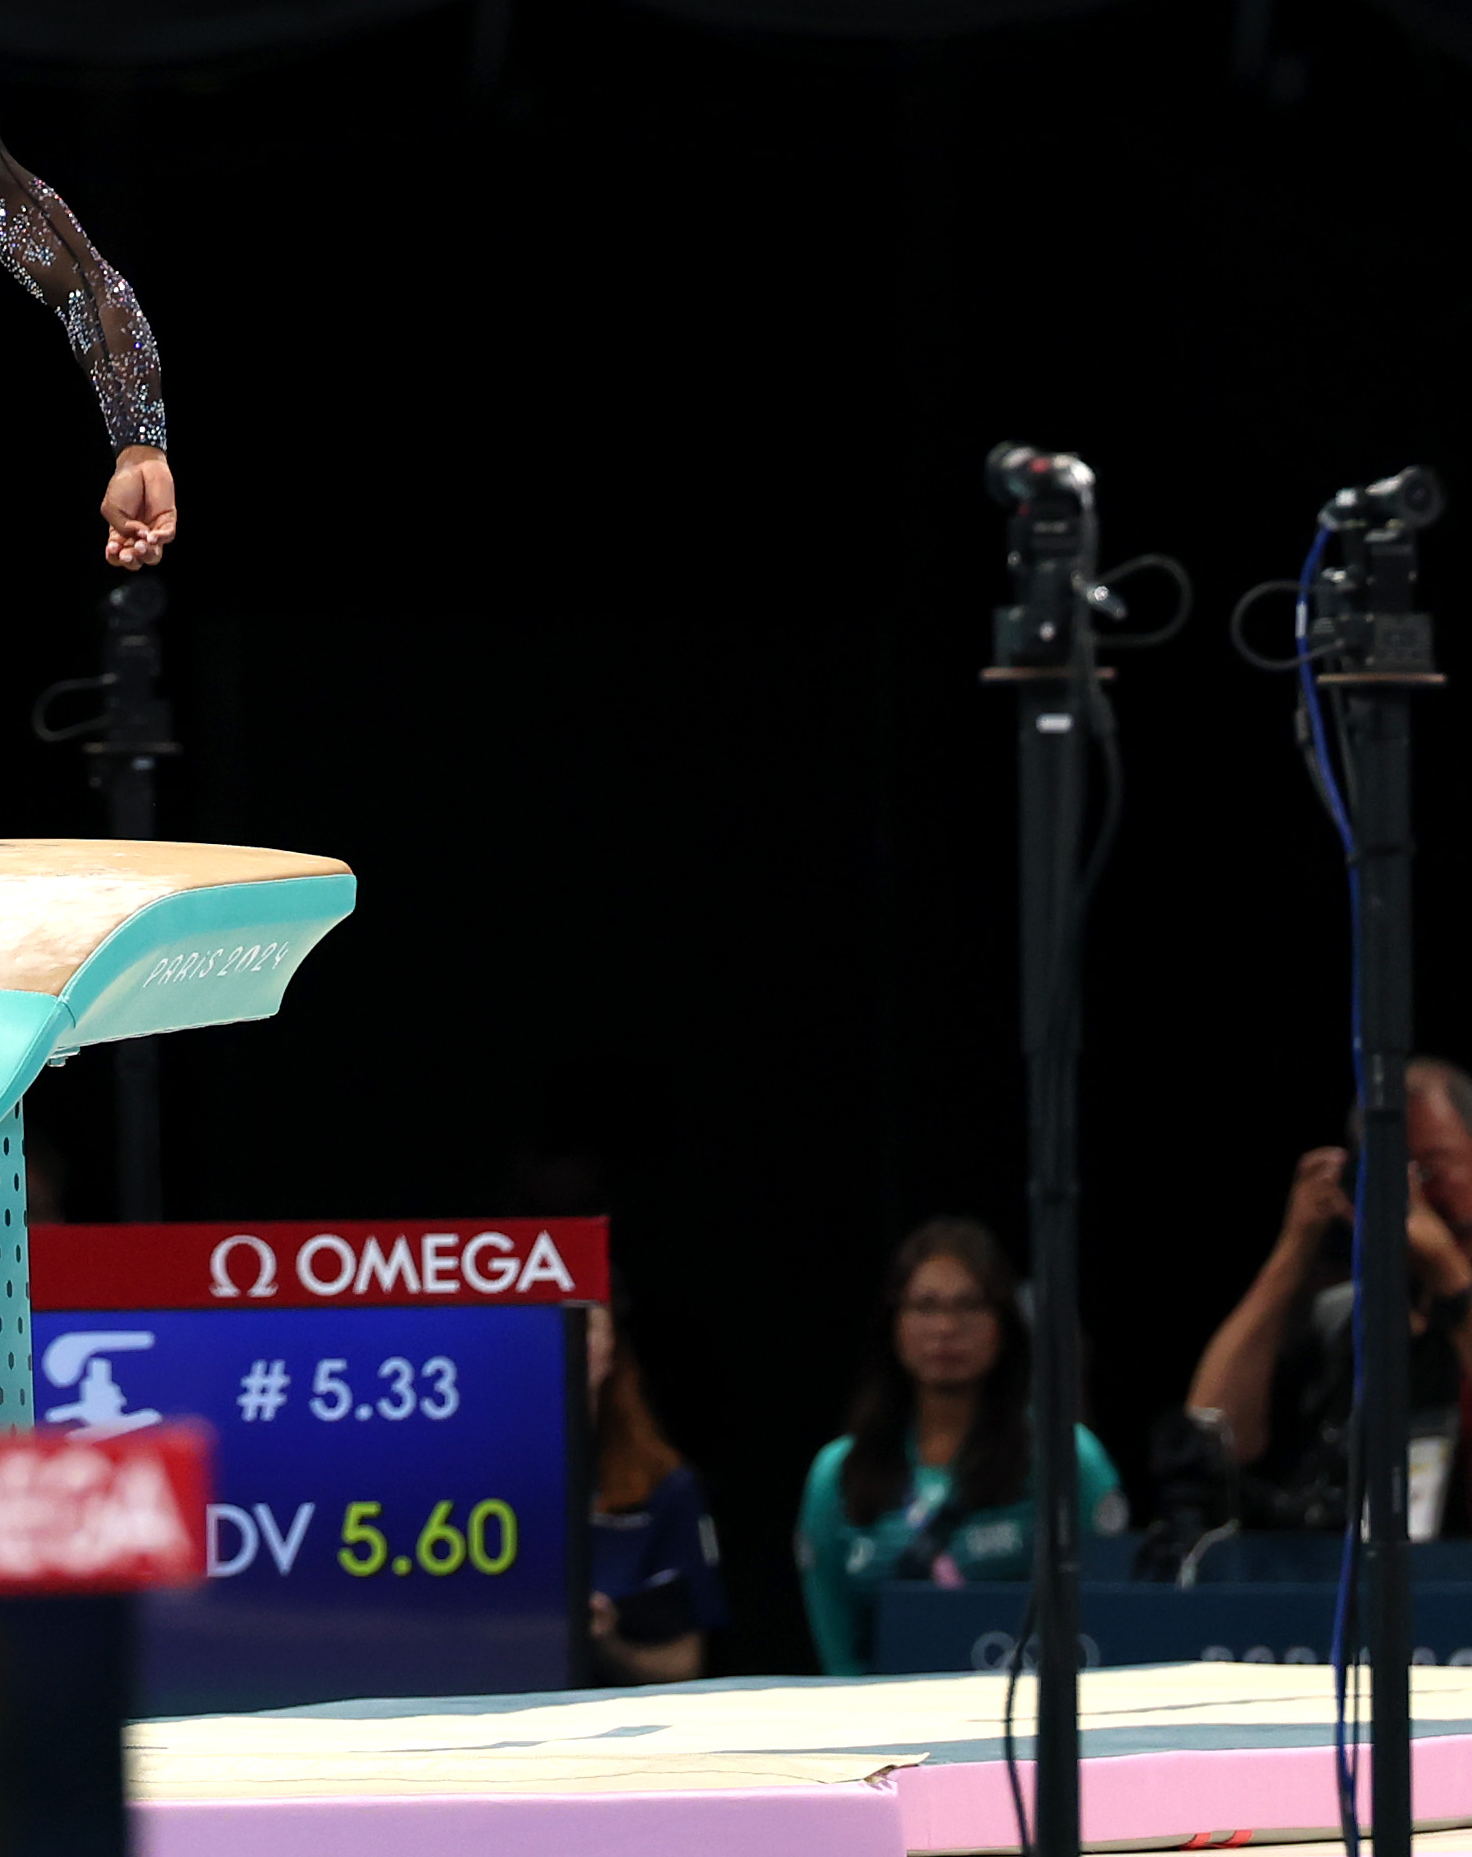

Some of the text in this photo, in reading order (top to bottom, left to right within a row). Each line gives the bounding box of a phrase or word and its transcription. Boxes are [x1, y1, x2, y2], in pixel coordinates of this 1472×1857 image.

[217, 941, 289, 977] 2024
[296, 1231, 575, 1296] OMEGA
[309, 1356, 460, 1422] 5.33
[206, 1498, 518, 1577] DV 5.60
